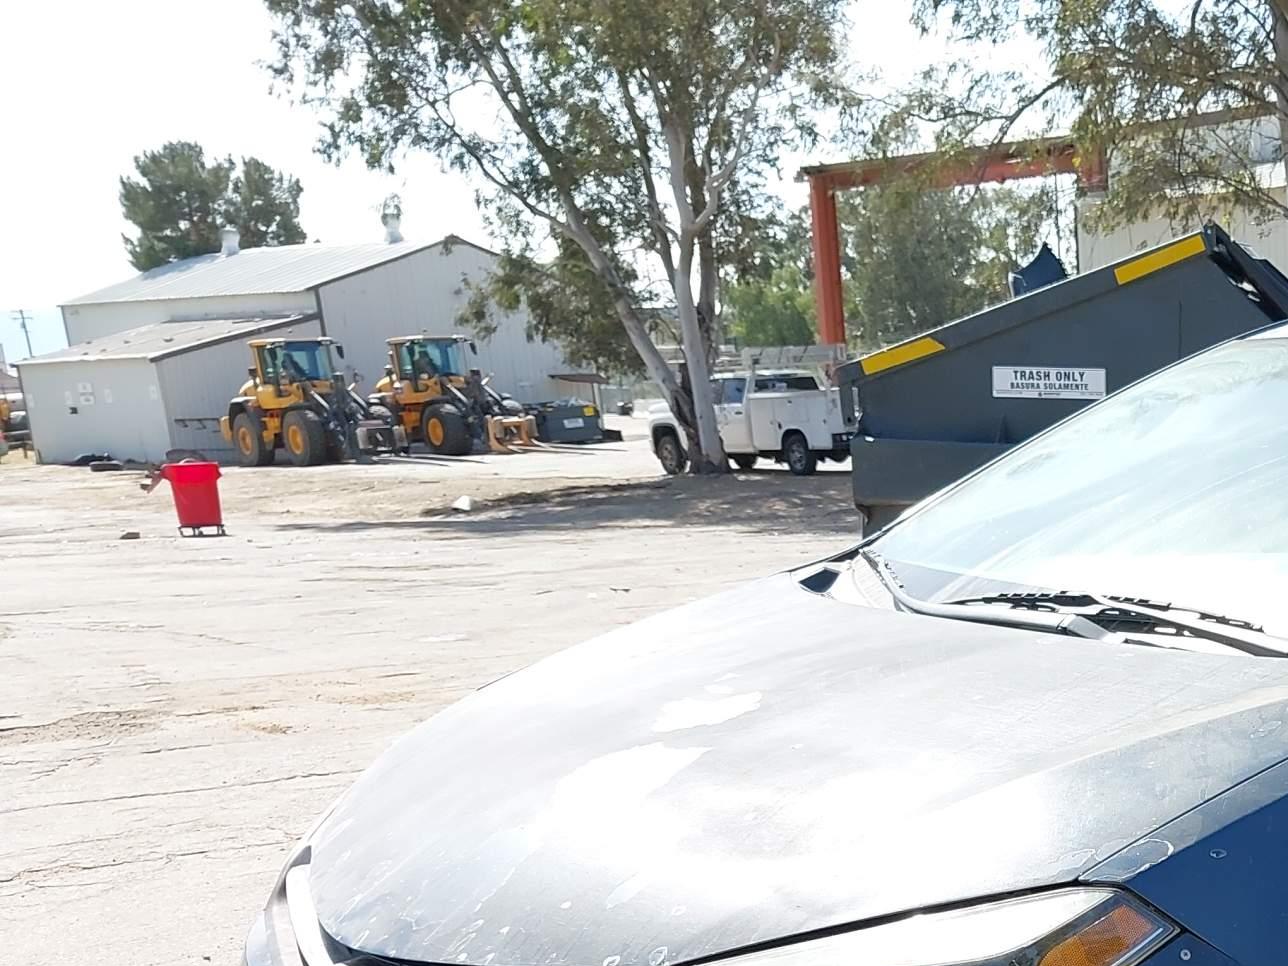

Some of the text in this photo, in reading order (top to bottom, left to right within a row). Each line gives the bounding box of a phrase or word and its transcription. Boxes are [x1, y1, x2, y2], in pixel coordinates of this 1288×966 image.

[1013, 370, 1086, 383] TRASH ONLY
[1010, 382, 1089, 391] BASURA SOLAMENTE
